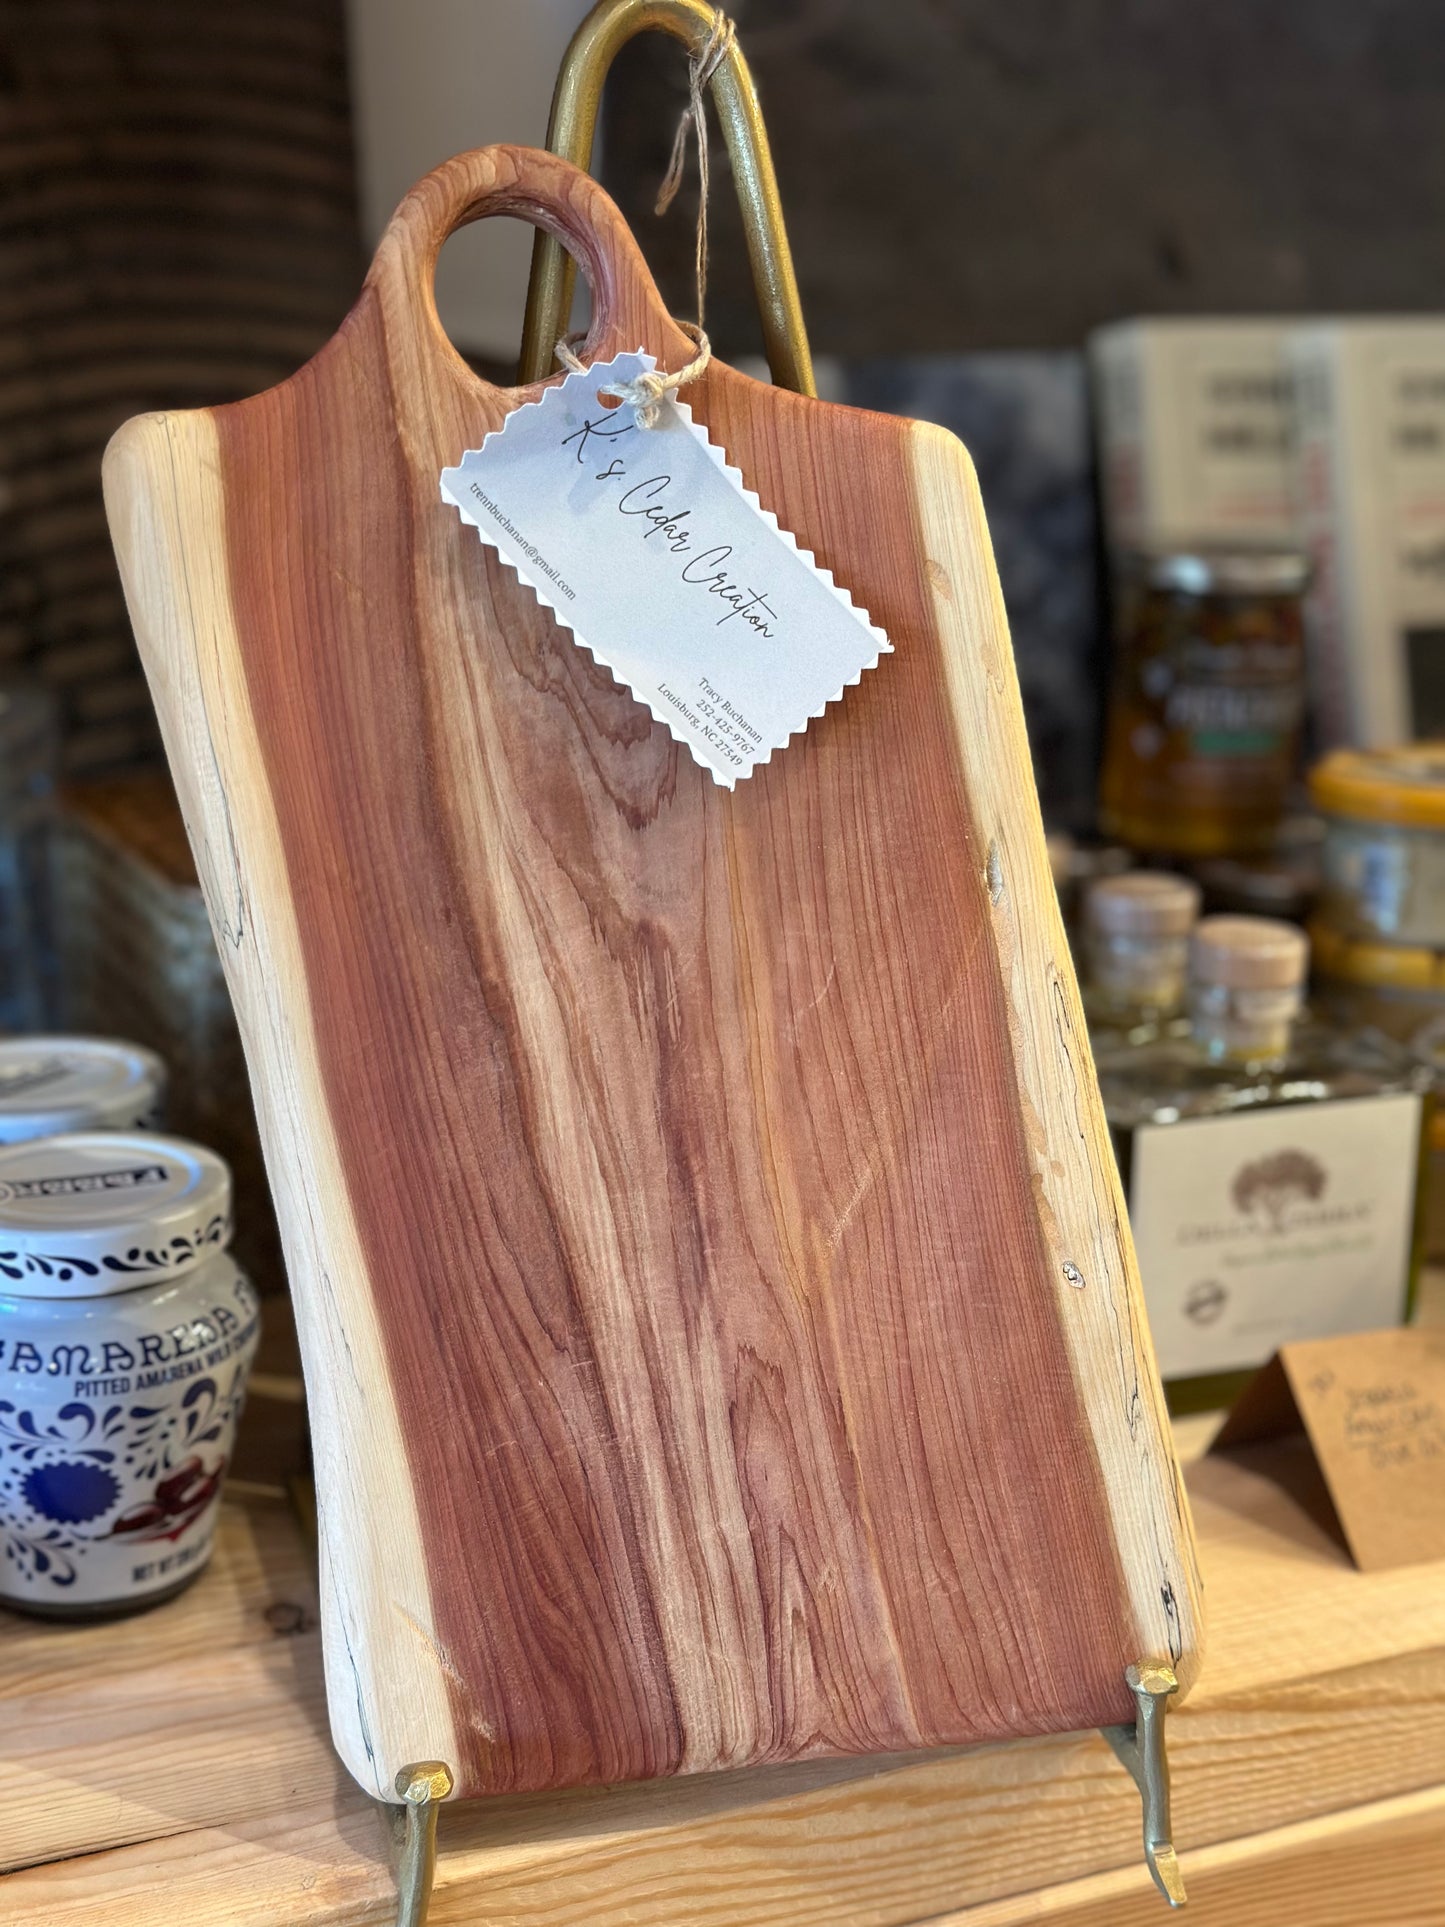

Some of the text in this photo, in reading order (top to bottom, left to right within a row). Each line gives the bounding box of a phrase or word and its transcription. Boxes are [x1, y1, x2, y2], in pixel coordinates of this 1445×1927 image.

[469, 482, 577, 601] trennbuchanan@gmail.com
[619, 476, 691, 552] Cedar
[682, 545, 778, 638] Creation
[657, 683, 743, 766] Louisburg, NC 27549
[696, 699, 756, 755] 252-425-9767
[698, 677, 763, 744] Tracy Buchanan
[74, 1376, 131, 1398] PITTED
